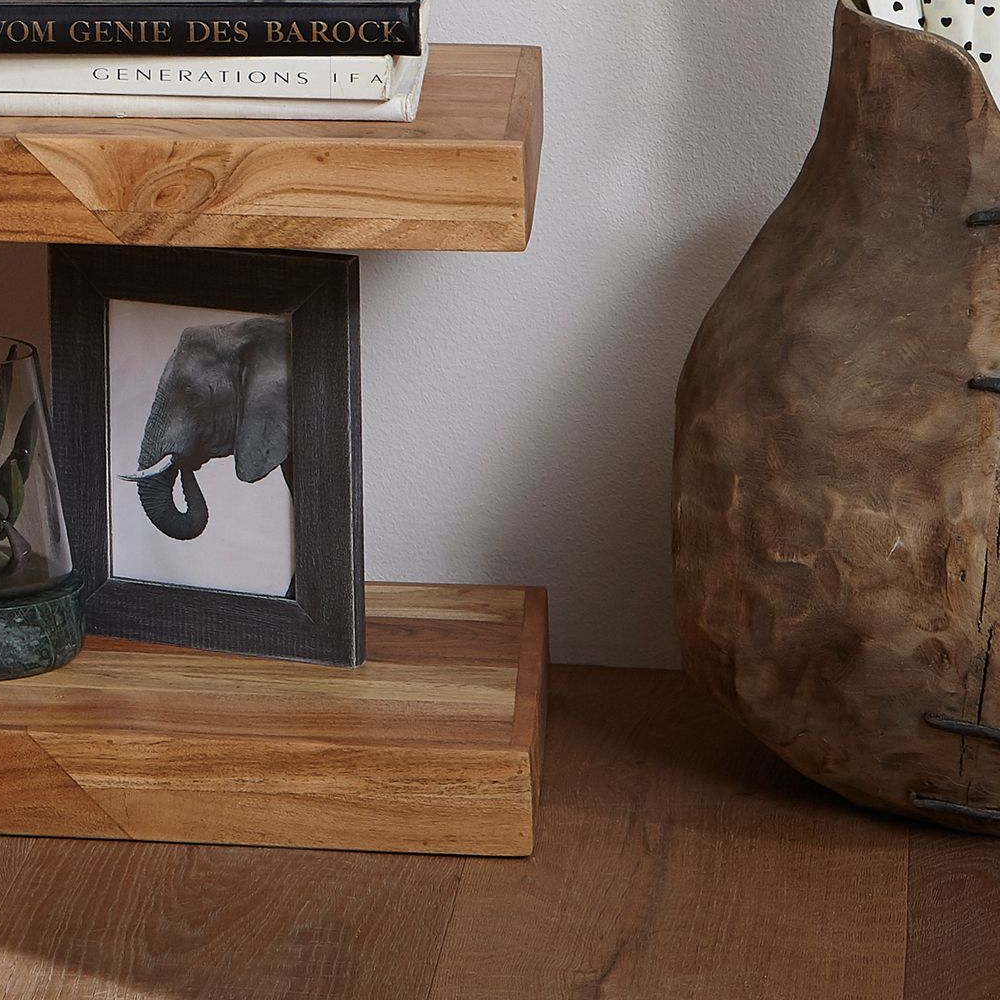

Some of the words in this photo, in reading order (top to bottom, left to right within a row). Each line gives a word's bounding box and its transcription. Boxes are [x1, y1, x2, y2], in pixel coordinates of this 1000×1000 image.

[69, 20, 172, 43] GENIE
[186, 20, 249, 44] DES
[264, 20, 405, 44] BAROCK
[92, 67, 309, 85] GENERATIONS
